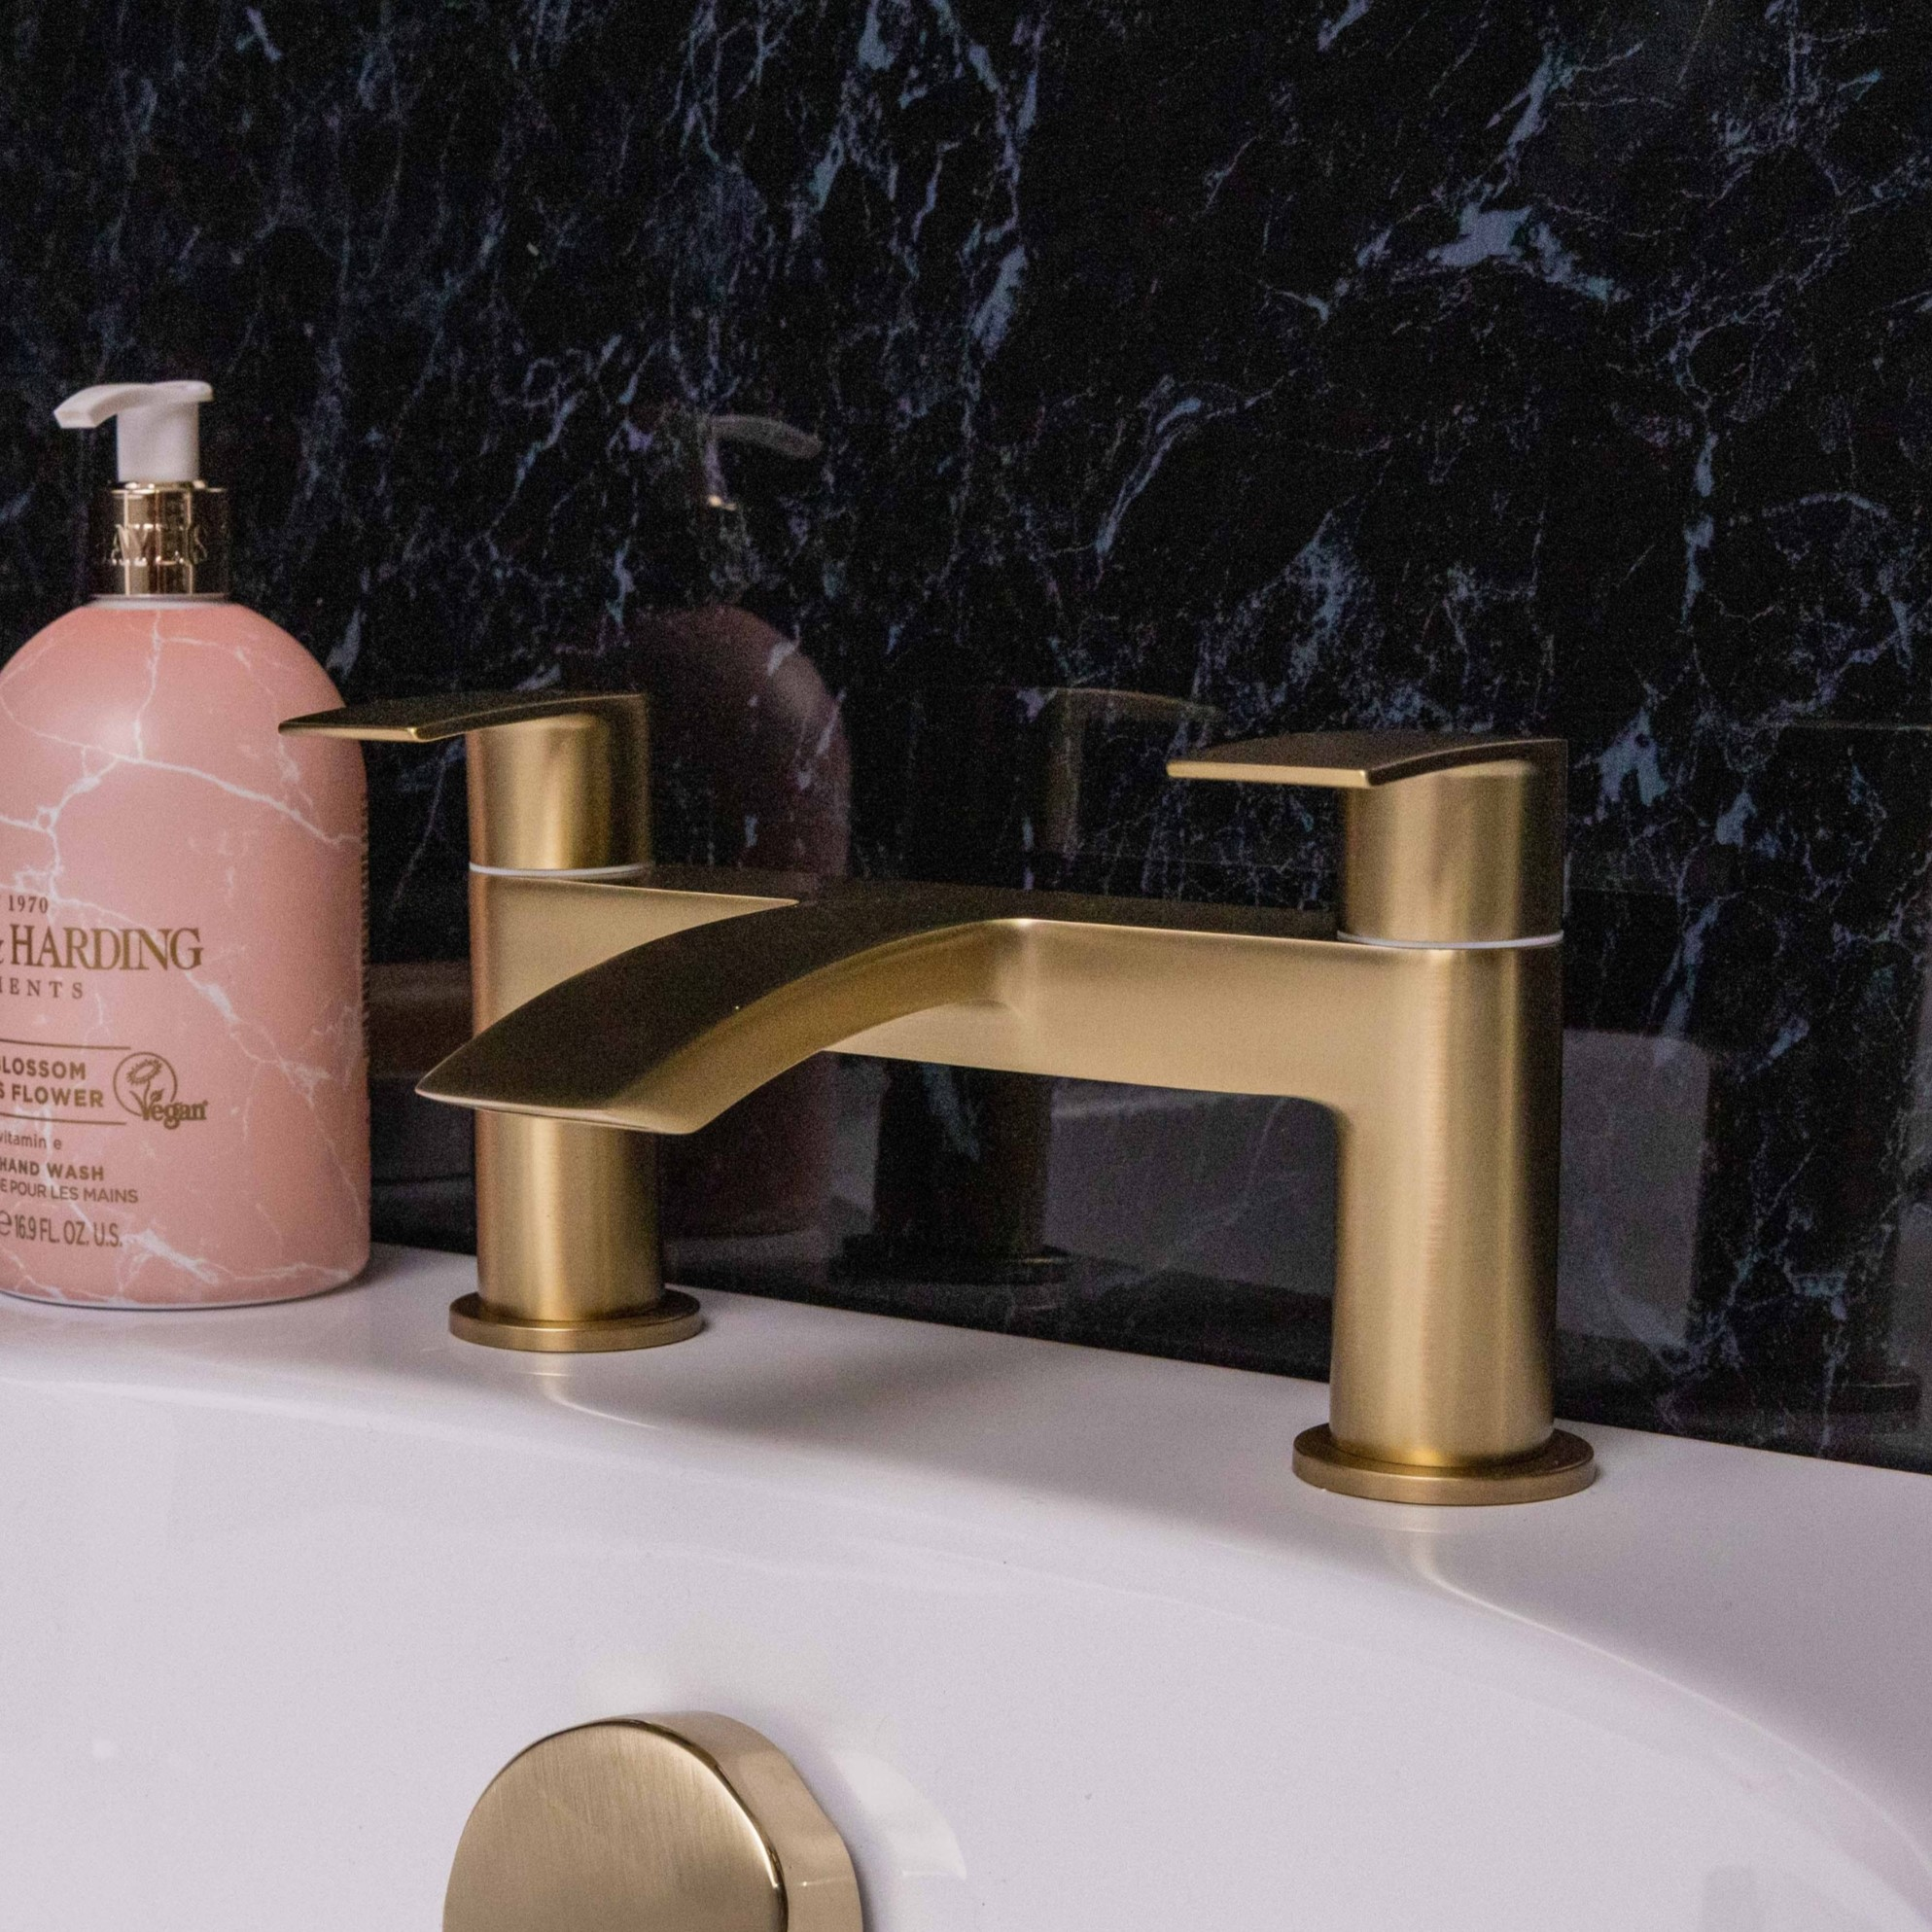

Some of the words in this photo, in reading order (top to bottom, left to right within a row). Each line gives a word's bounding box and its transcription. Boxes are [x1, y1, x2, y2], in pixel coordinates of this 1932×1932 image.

[8, 895, 49, 914] 1970
[10, 924, 204, 970] HARDING
[0, 976, 84, 1000] ENTS
[0, 1056, 86, 1080] LOSSOM
[12, 1083, 104, 1107] FLOWER
[140, 1100, 206, 1130] Vegan
[53, 1139, 62, 1150] e
[47, 1162, 105, 1181] WASH
[10, 1179, 47, 1198] POUR
[51, 1184, 79, 1201] LES
[83, 1187, 139, 1204] MAINS
[93, 1221, 123, 1247] U.S.
